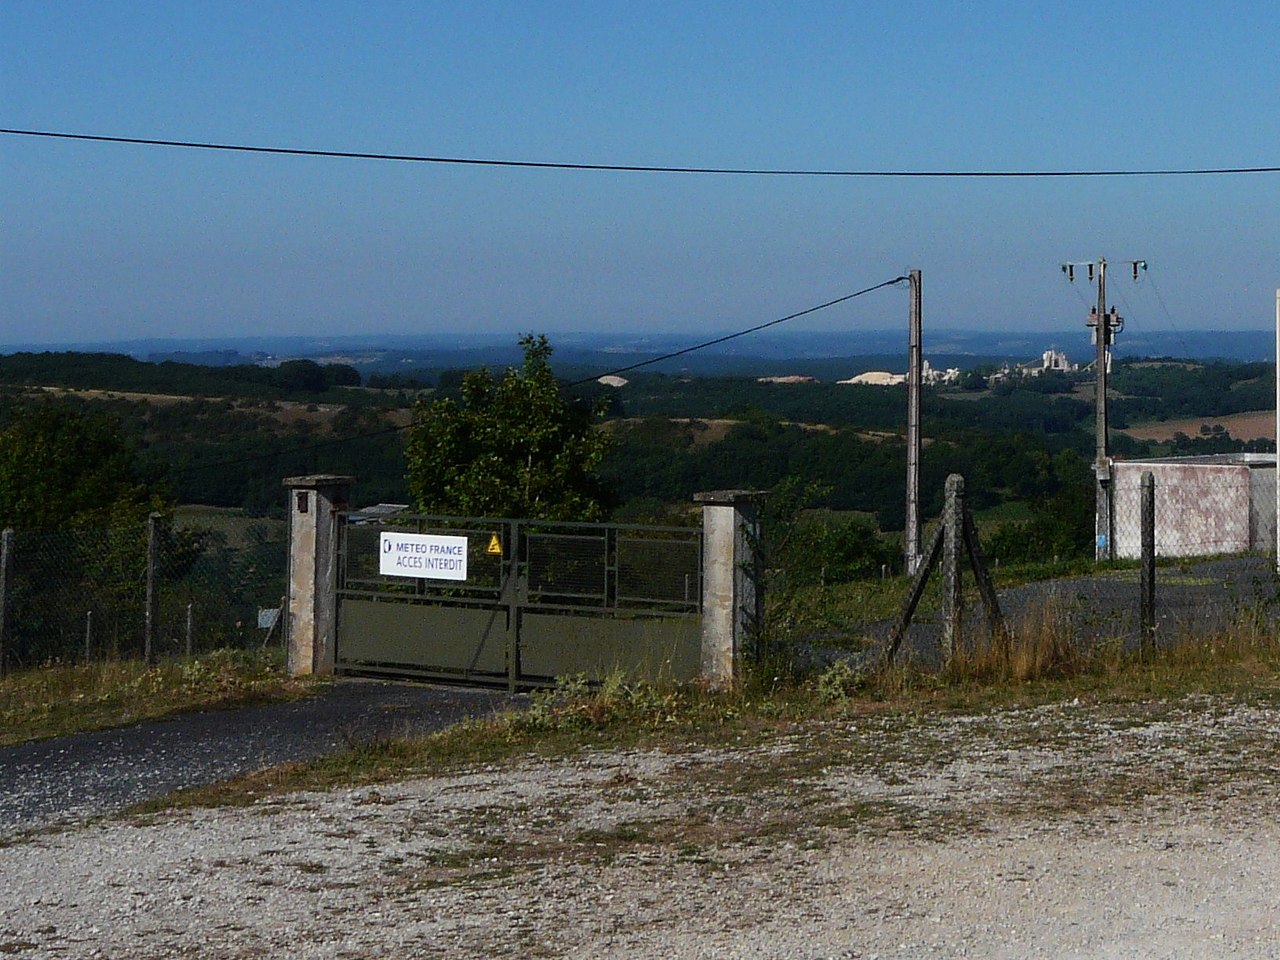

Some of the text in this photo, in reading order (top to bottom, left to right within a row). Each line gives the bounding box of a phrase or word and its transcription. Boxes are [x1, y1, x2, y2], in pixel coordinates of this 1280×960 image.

[396, 543, 463, 555] METEO FRANCE
[396, 556, 463, 571] ACCES INTERDIT
